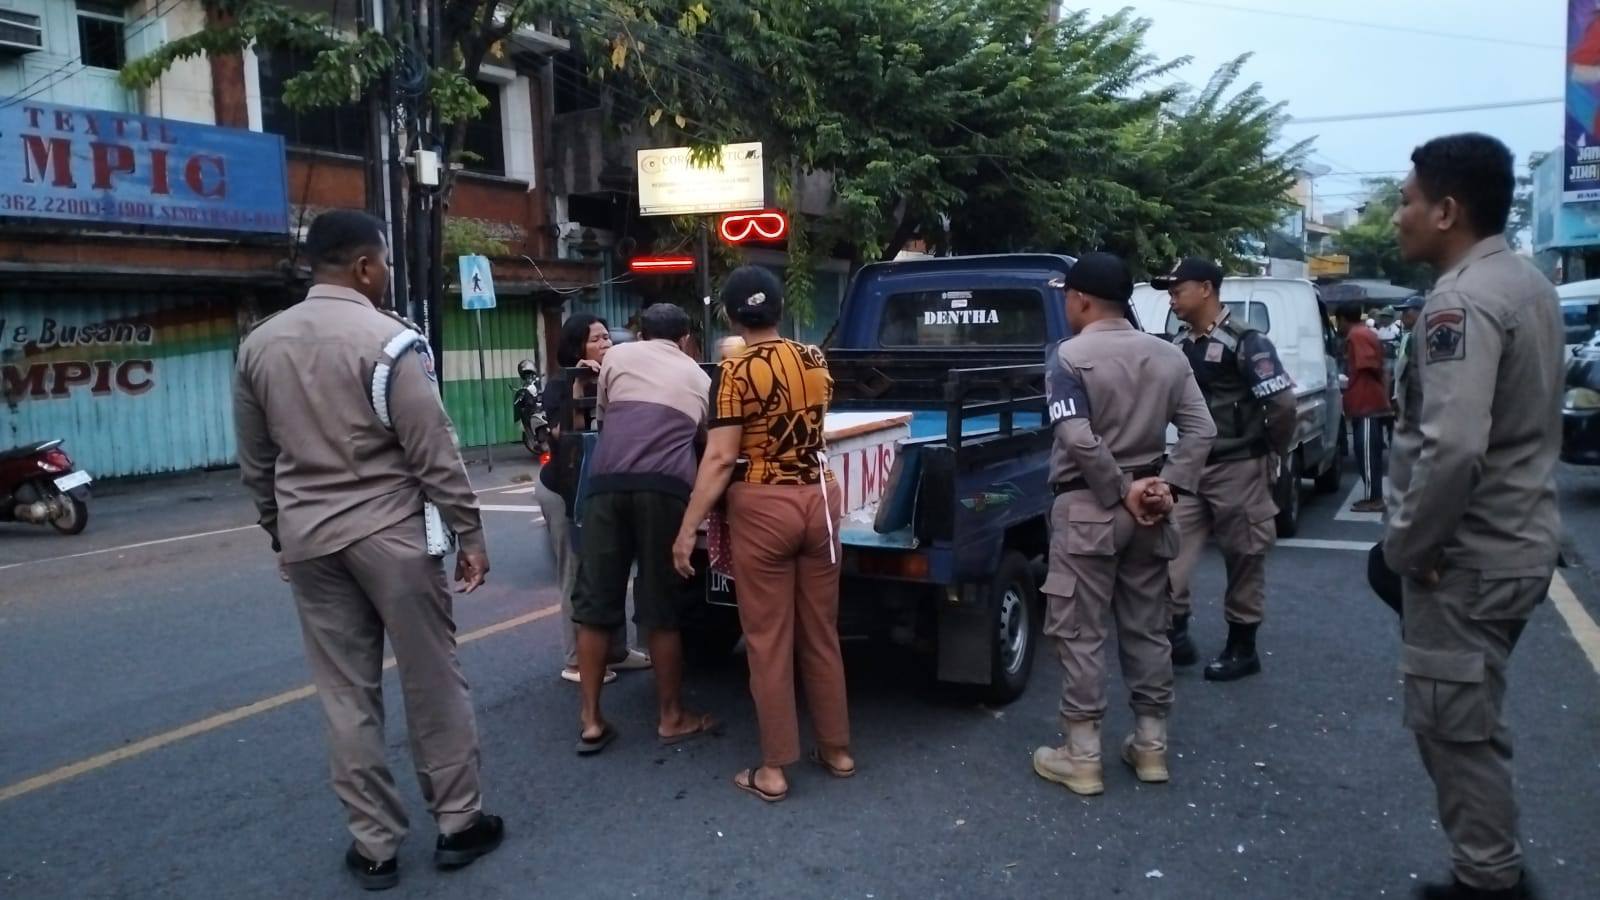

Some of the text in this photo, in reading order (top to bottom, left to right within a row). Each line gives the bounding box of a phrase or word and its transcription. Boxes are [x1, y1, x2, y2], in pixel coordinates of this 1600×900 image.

[23, 105, 178, 145] TEXTIL
[0, 132, 227, 199] MPIC
[39, 317, 152, 345] Busana
[923, 309, 1000, 325] DENTHA
